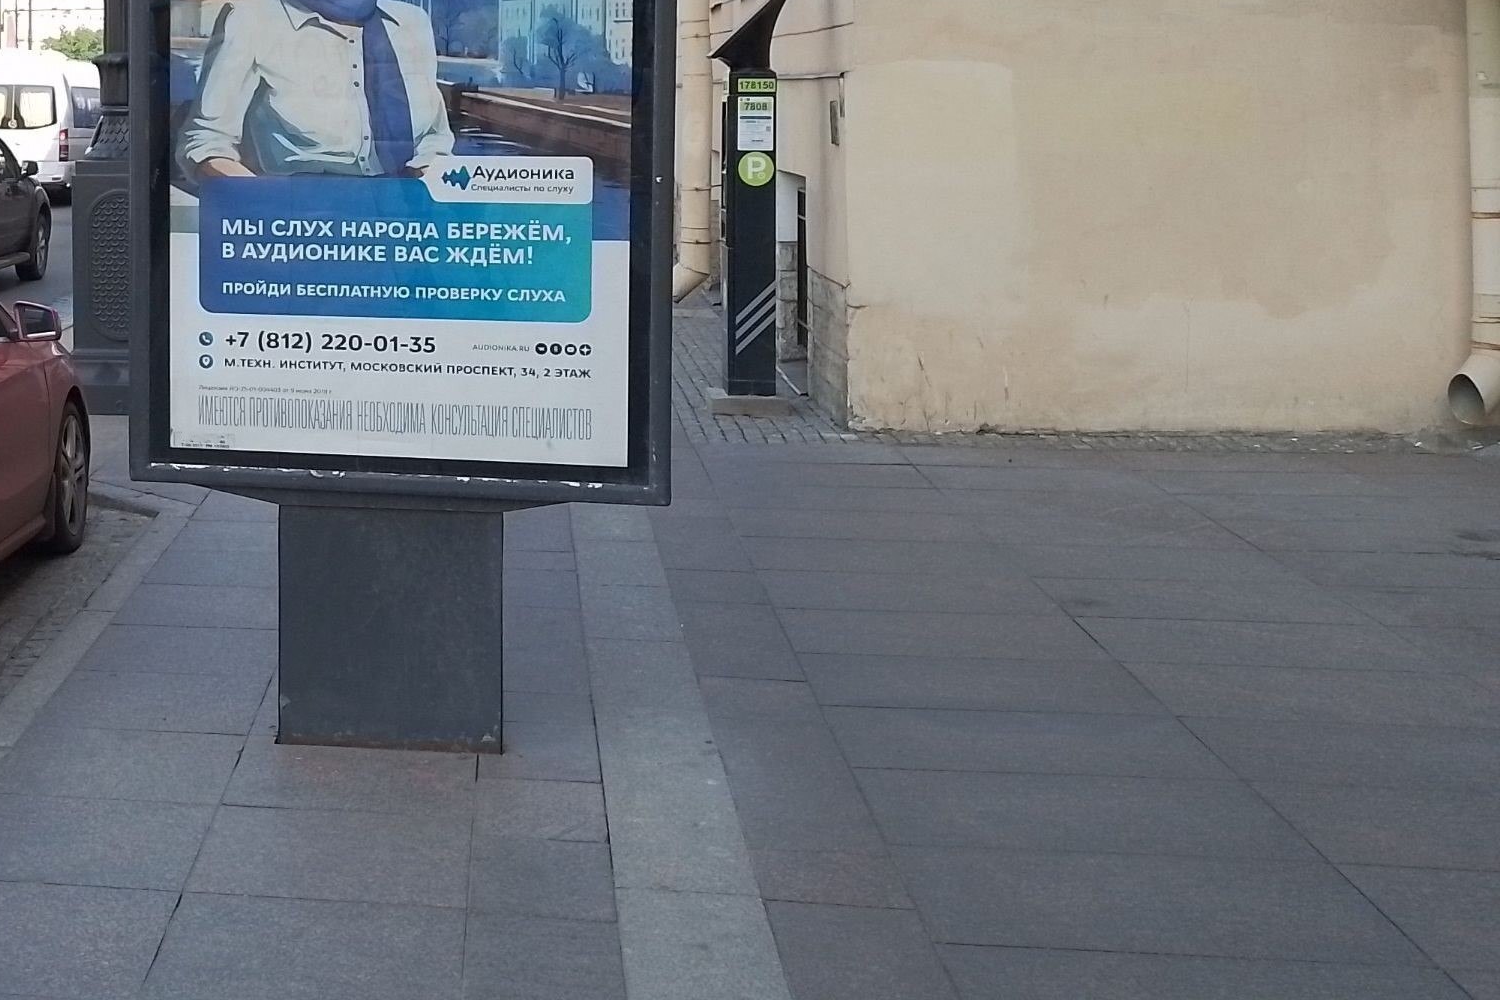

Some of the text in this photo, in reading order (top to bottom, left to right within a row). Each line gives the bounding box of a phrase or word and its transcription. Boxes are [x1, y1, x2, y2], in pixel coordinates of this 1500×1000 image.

[739, 81, 774, 90] 178150
[472, 165, 575, 182] Аудионика
[471, 183, 531, 193] Специалисты
[547, 185, 574, 195] слуху
[221, 219, 573, 245] МЫ СЛУХ НАРОДА БЕРЕЖЁМ,
[221, 242, 534, 267] В АУДИОНИКЕ ВАС ЖДЁМ!
[222, 280, 567, 302] ПРОЙДИ БЕСПЛАТНУЮ ПРОВЕРКУ СЛУХА
[225, 330, 437, 353] +7 (812) 220-01-35
[472, 344, 530, 353] AUDIONIKA.RU
[224, 358, 593, 379] М.ТЕХН. ИНСТИТУТ, МОСКОВСКИЙ ПРОСПЕКТ, 34, 2 ЭТАЖ
[198, 395, 593, 441] ИМЕЮТСЯ ПРОТИВОПОКАЗАНИЯ НЕОБХОДИМА КОНСУЛЬТАЦИЯ СПЕЦИАЛИСТОВ
